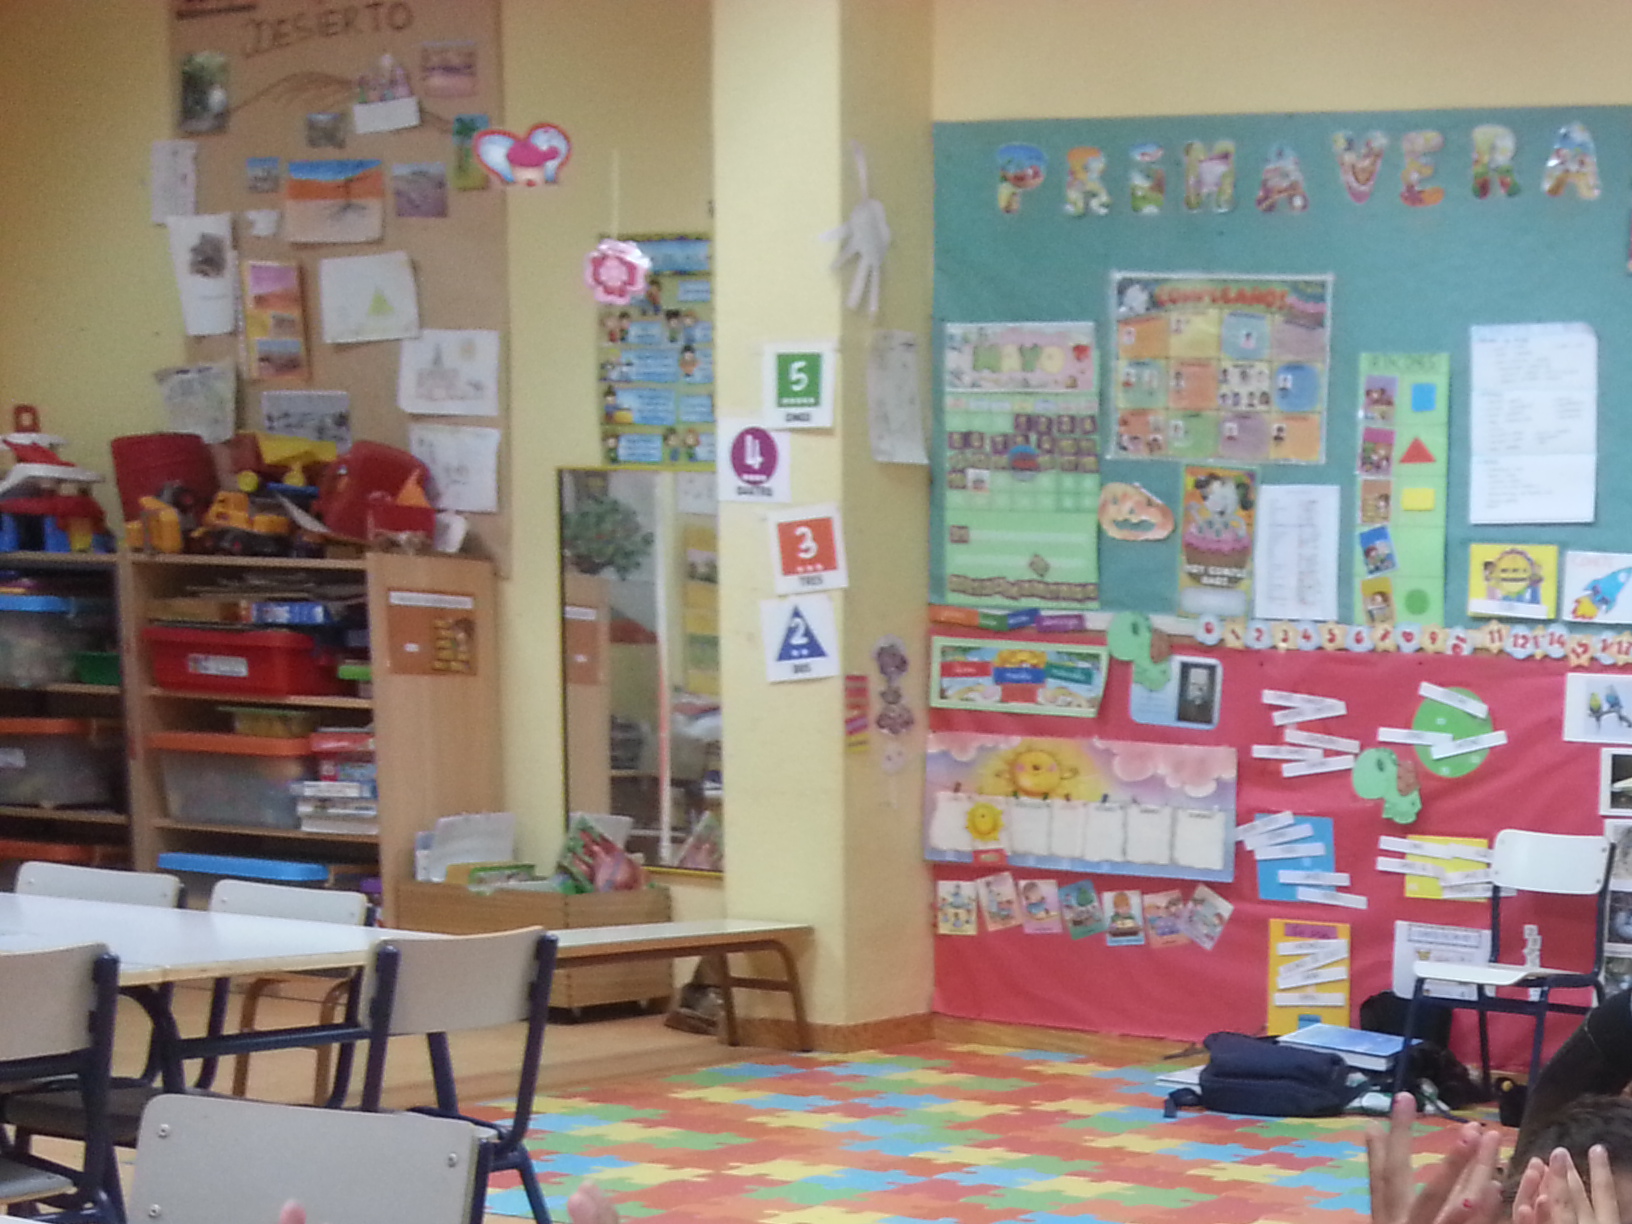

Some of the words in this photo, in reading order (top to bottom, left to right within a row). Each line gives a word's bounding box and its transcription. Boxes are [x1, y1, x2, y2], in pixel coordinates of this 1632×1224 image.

[789, 360, 809, 391] 5
[744, 434, 764, 470] 4
[794, 525, 818, 559] 3
[790, 617, 809, 645] 2
[1489, 630, 1502, 643] 11
[1513, 633, 1529, 649] 12
[1549, 632, 1566, 648] 14
